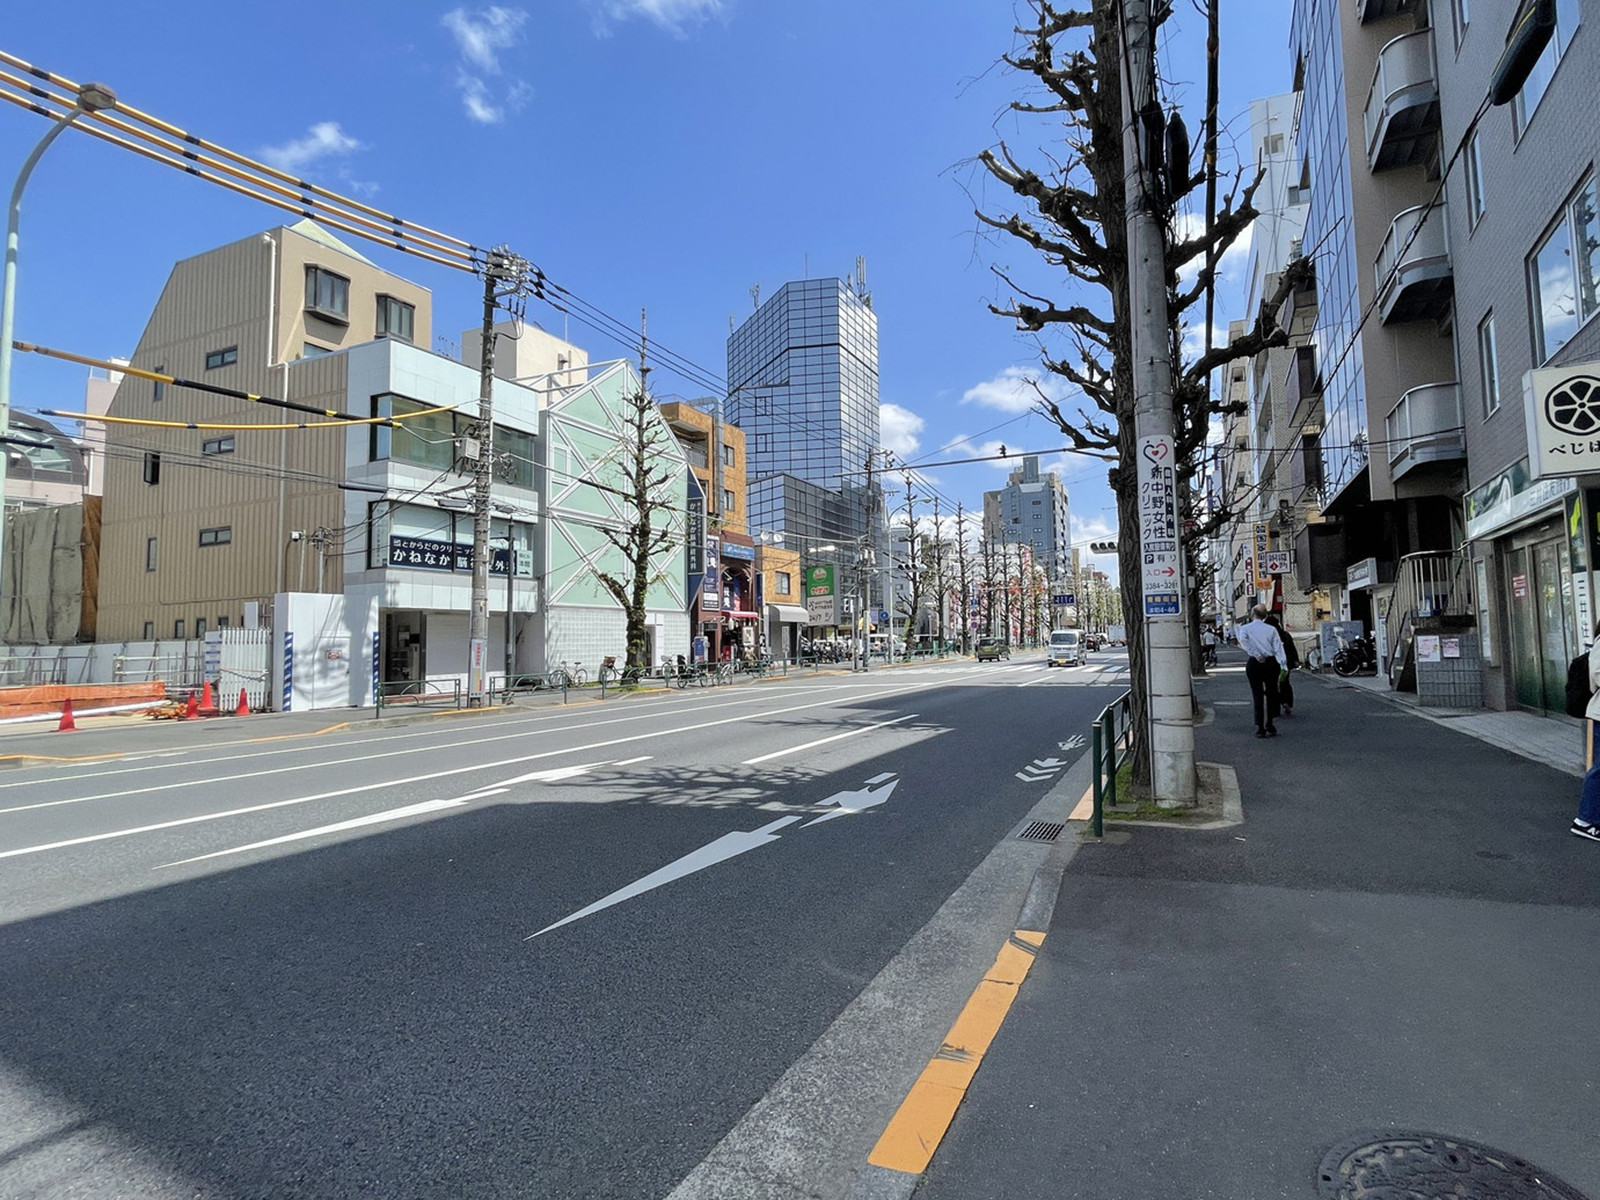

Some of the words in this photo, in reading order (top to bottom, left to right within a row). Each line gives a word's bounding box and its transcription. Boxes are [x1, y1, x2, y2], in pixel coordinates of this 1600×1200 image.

[1142, 482, 1152, 540] クリニック
[1151, 467, 1166, 538] 新中野女性
[1146, 569, 1161, 577] 入口
